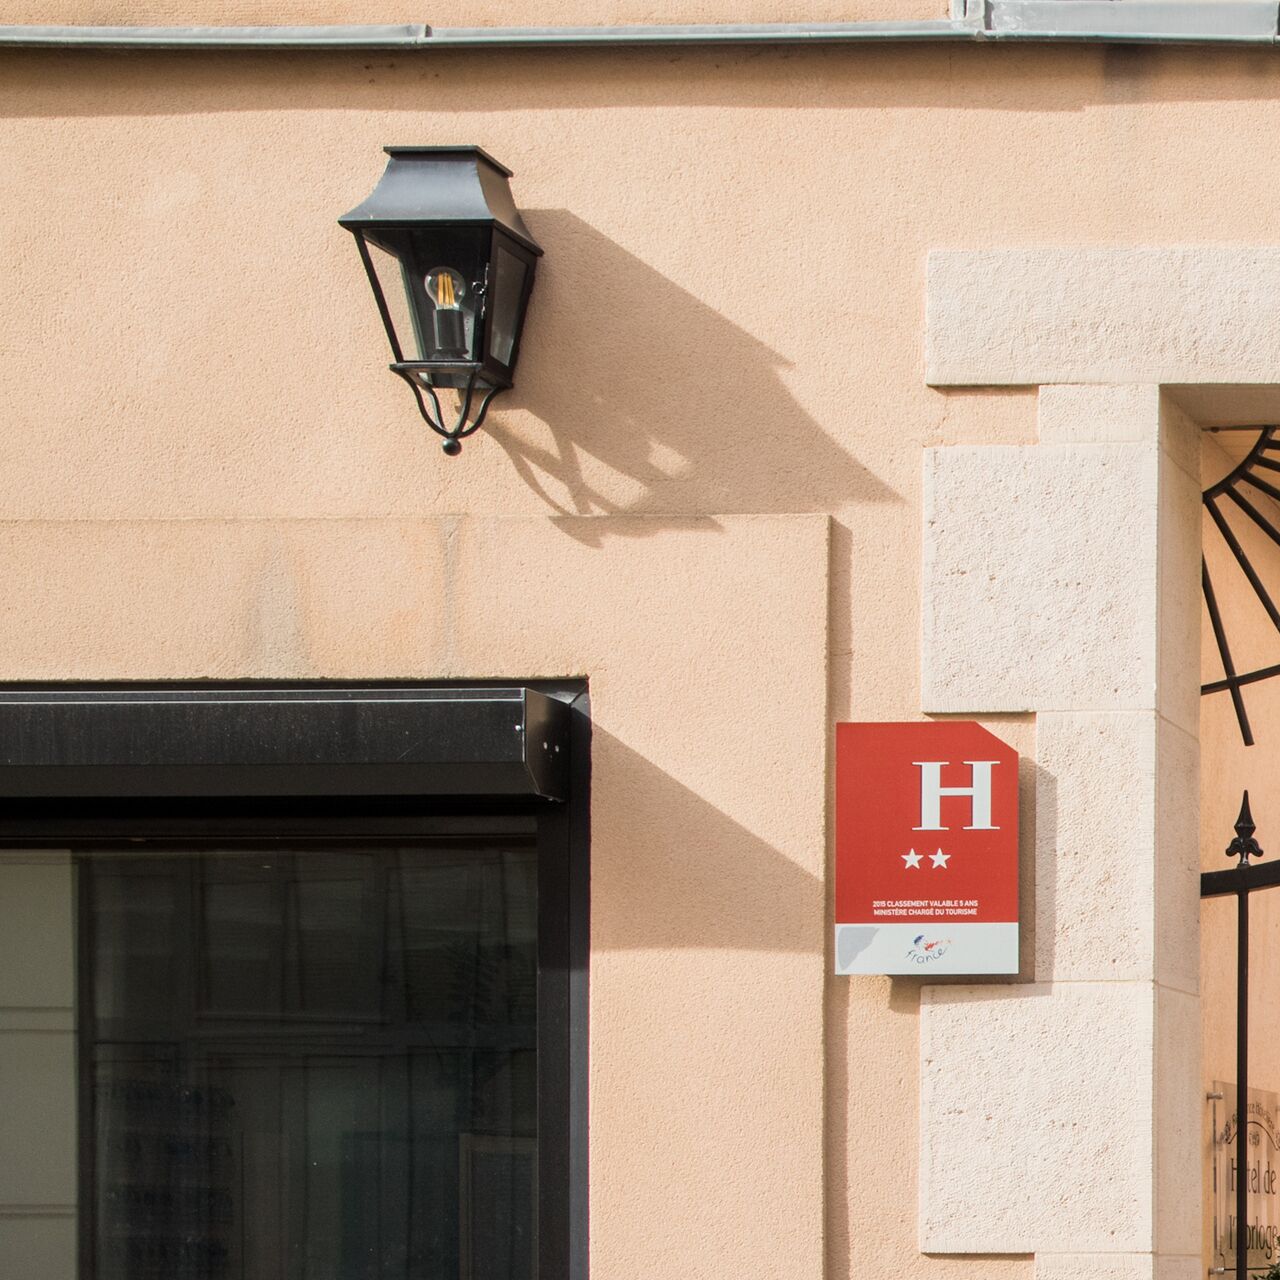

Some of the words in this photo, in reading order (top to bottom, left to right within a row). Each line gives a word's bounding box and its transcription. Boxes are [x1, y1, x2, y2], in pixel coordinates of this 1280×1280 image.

[911, 761, 1001, 831] H
[934, 908, 944, 916] DU
[945, 908, 977, 916] TOURISME
[1230, 1158, 1260, 1195] Htel
[1263, 1161, 1277, 1195] de
